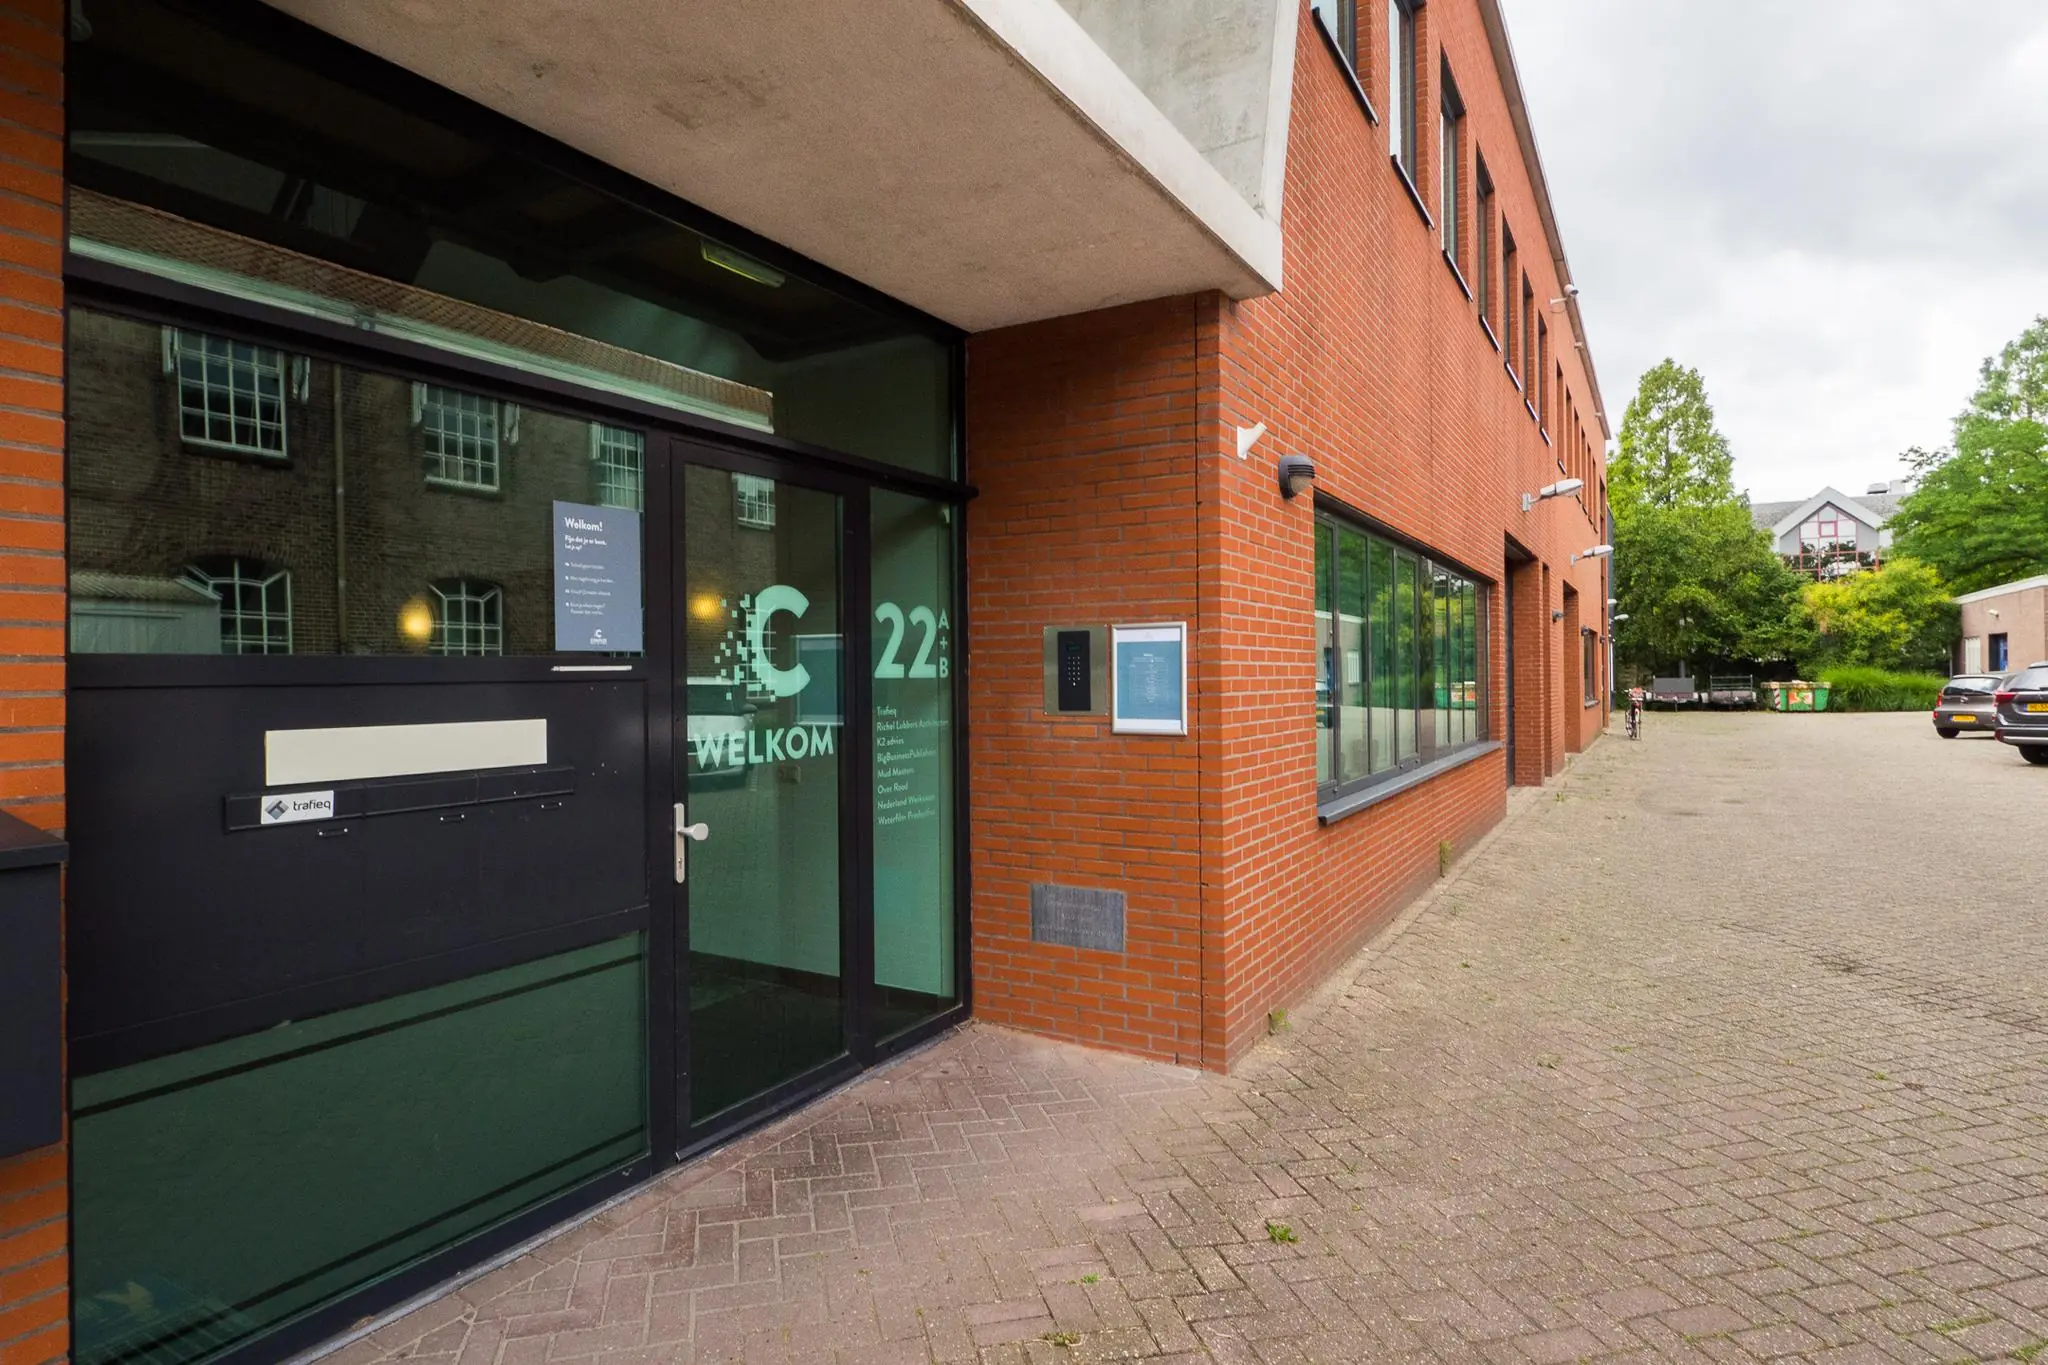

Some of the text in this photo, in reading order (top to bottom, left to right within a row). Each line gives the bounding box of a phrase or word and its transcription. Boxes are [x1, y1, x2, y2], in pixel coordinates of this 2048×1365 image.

[564, 516, 603, 532] Welkom!
[938, 608, 950, 630] A
[874, 601, 937, 679] 22
[939, 656, 949, 679] B
[693, 724, 834, 769] WELKOM
[877, 783, 893, 794] Over
[292, 799, 331, 812] trafieq
